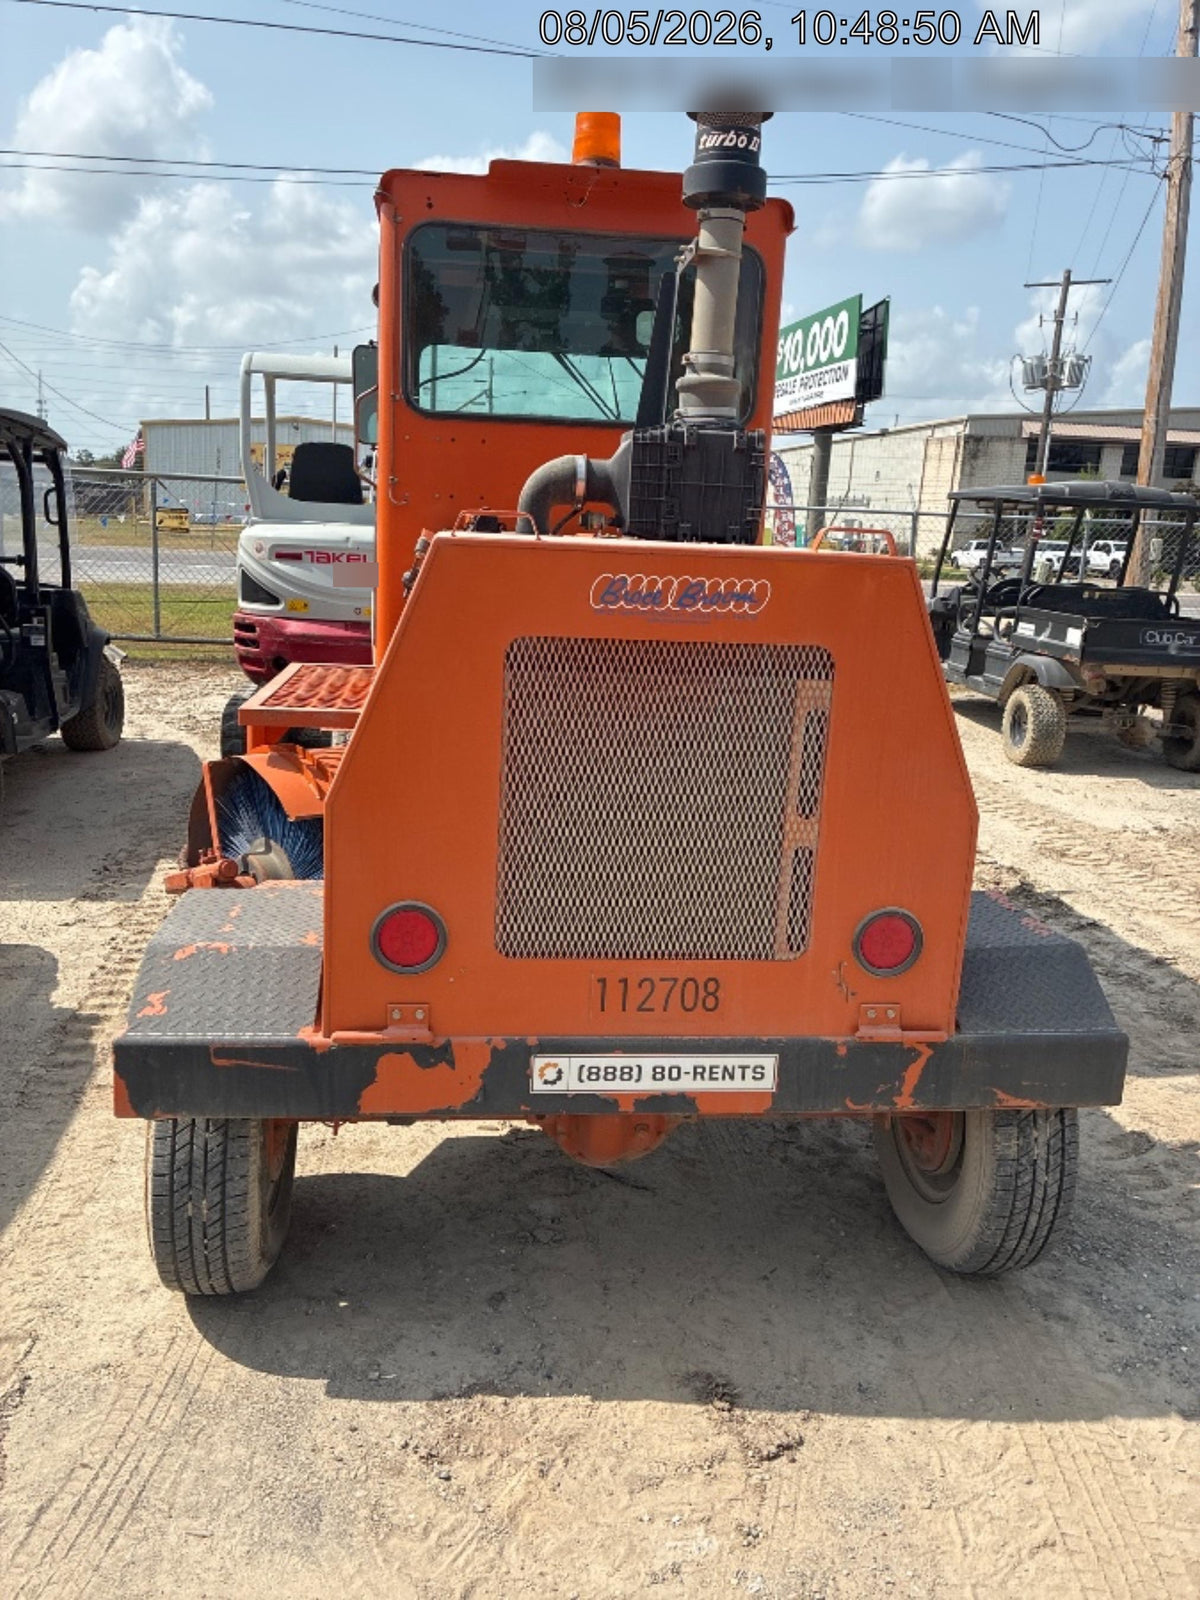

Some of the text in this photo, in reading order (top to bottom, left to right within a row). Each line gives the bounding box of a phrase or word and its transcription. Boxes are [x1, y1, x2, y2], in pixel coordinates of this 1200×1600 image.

[698, 130, 748, 150] turbo
[775, 380, 796, 400] ESALE
[800, 364, 850, 391] PROTECTION
[1145, 630, 1198, 646] Club Car
[596, 976, 721, 1013] 112708
[577, 1064, 766, 1083] (888) 80-RENTS
